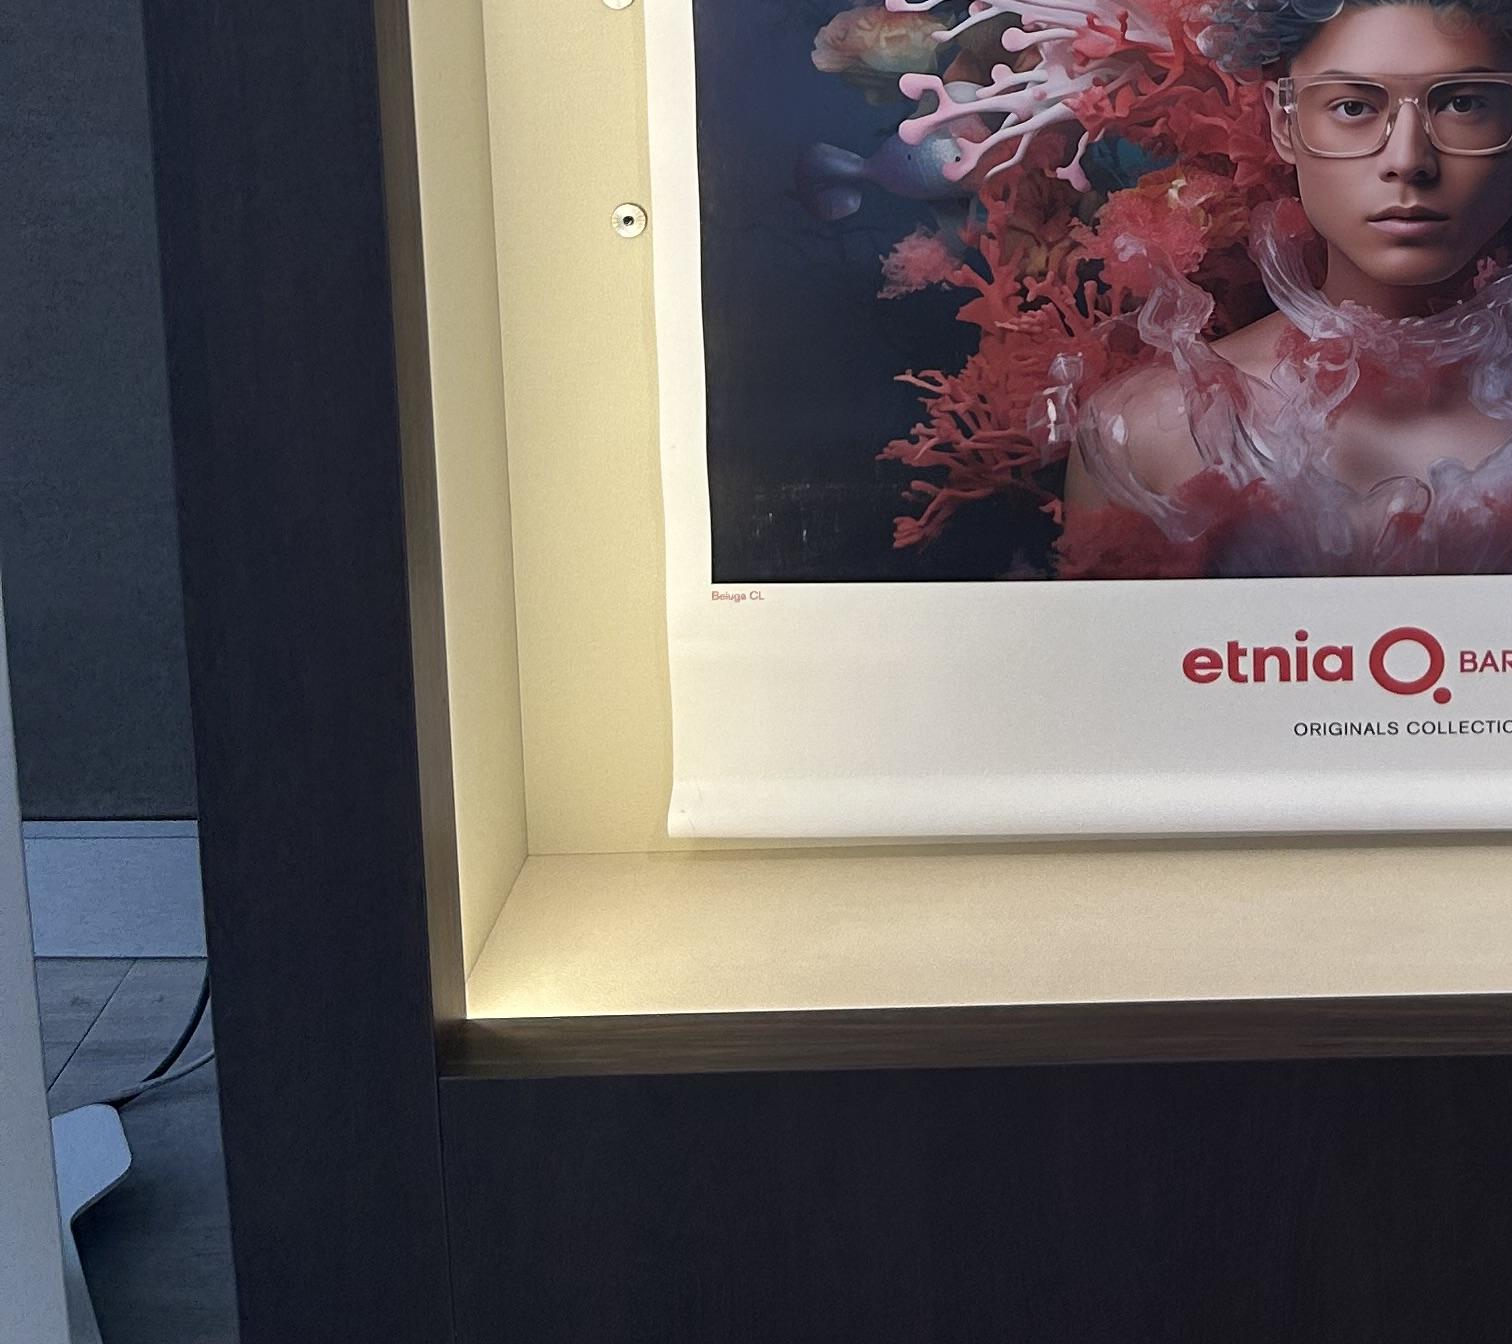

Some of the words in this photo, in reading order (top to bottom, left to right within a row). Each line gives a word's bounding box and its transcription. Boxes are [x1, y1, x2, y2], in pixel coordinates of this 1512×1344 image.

[749, 590, 765, 600] CL
[1182, 629, 1354, 684] etnia
[1293, 721, 1399, 736] ORIGINALS
